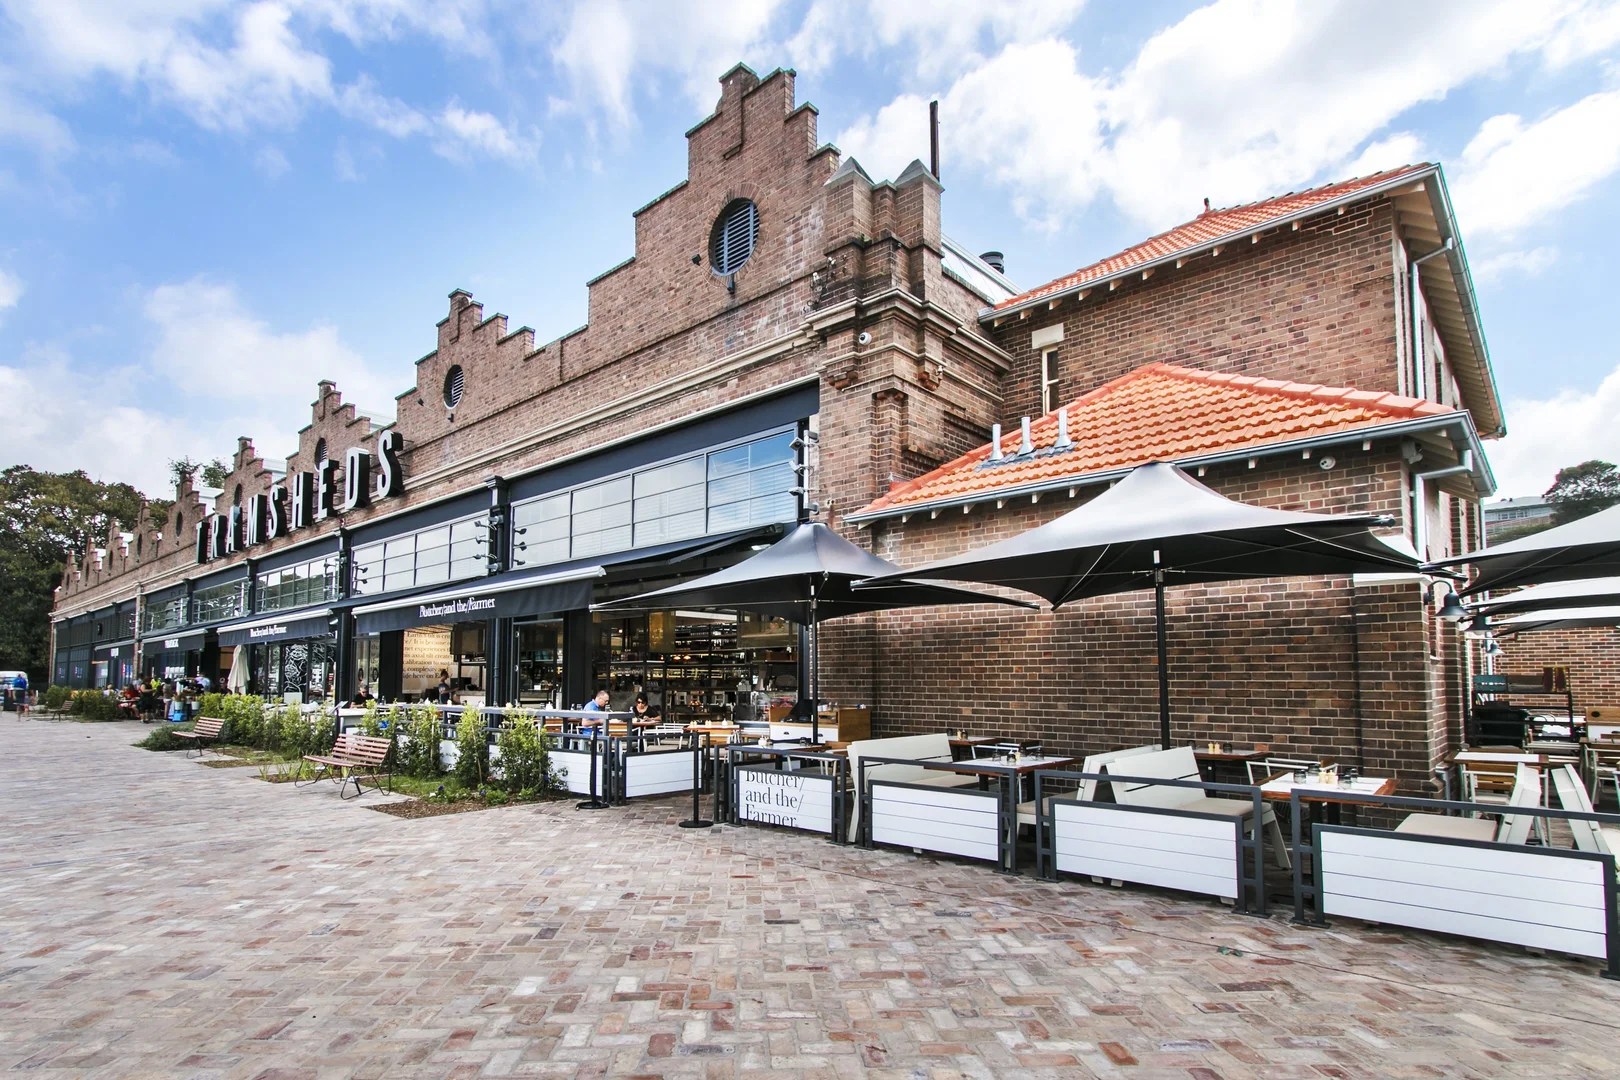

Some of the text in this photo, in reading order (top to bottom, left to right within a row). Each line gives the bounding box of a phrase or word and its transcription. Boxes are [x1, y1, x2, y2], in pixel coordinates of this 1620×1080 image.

[196, 429, 403, 564] TRAMSHEDS
[745, 786, 805, 812] and the/
